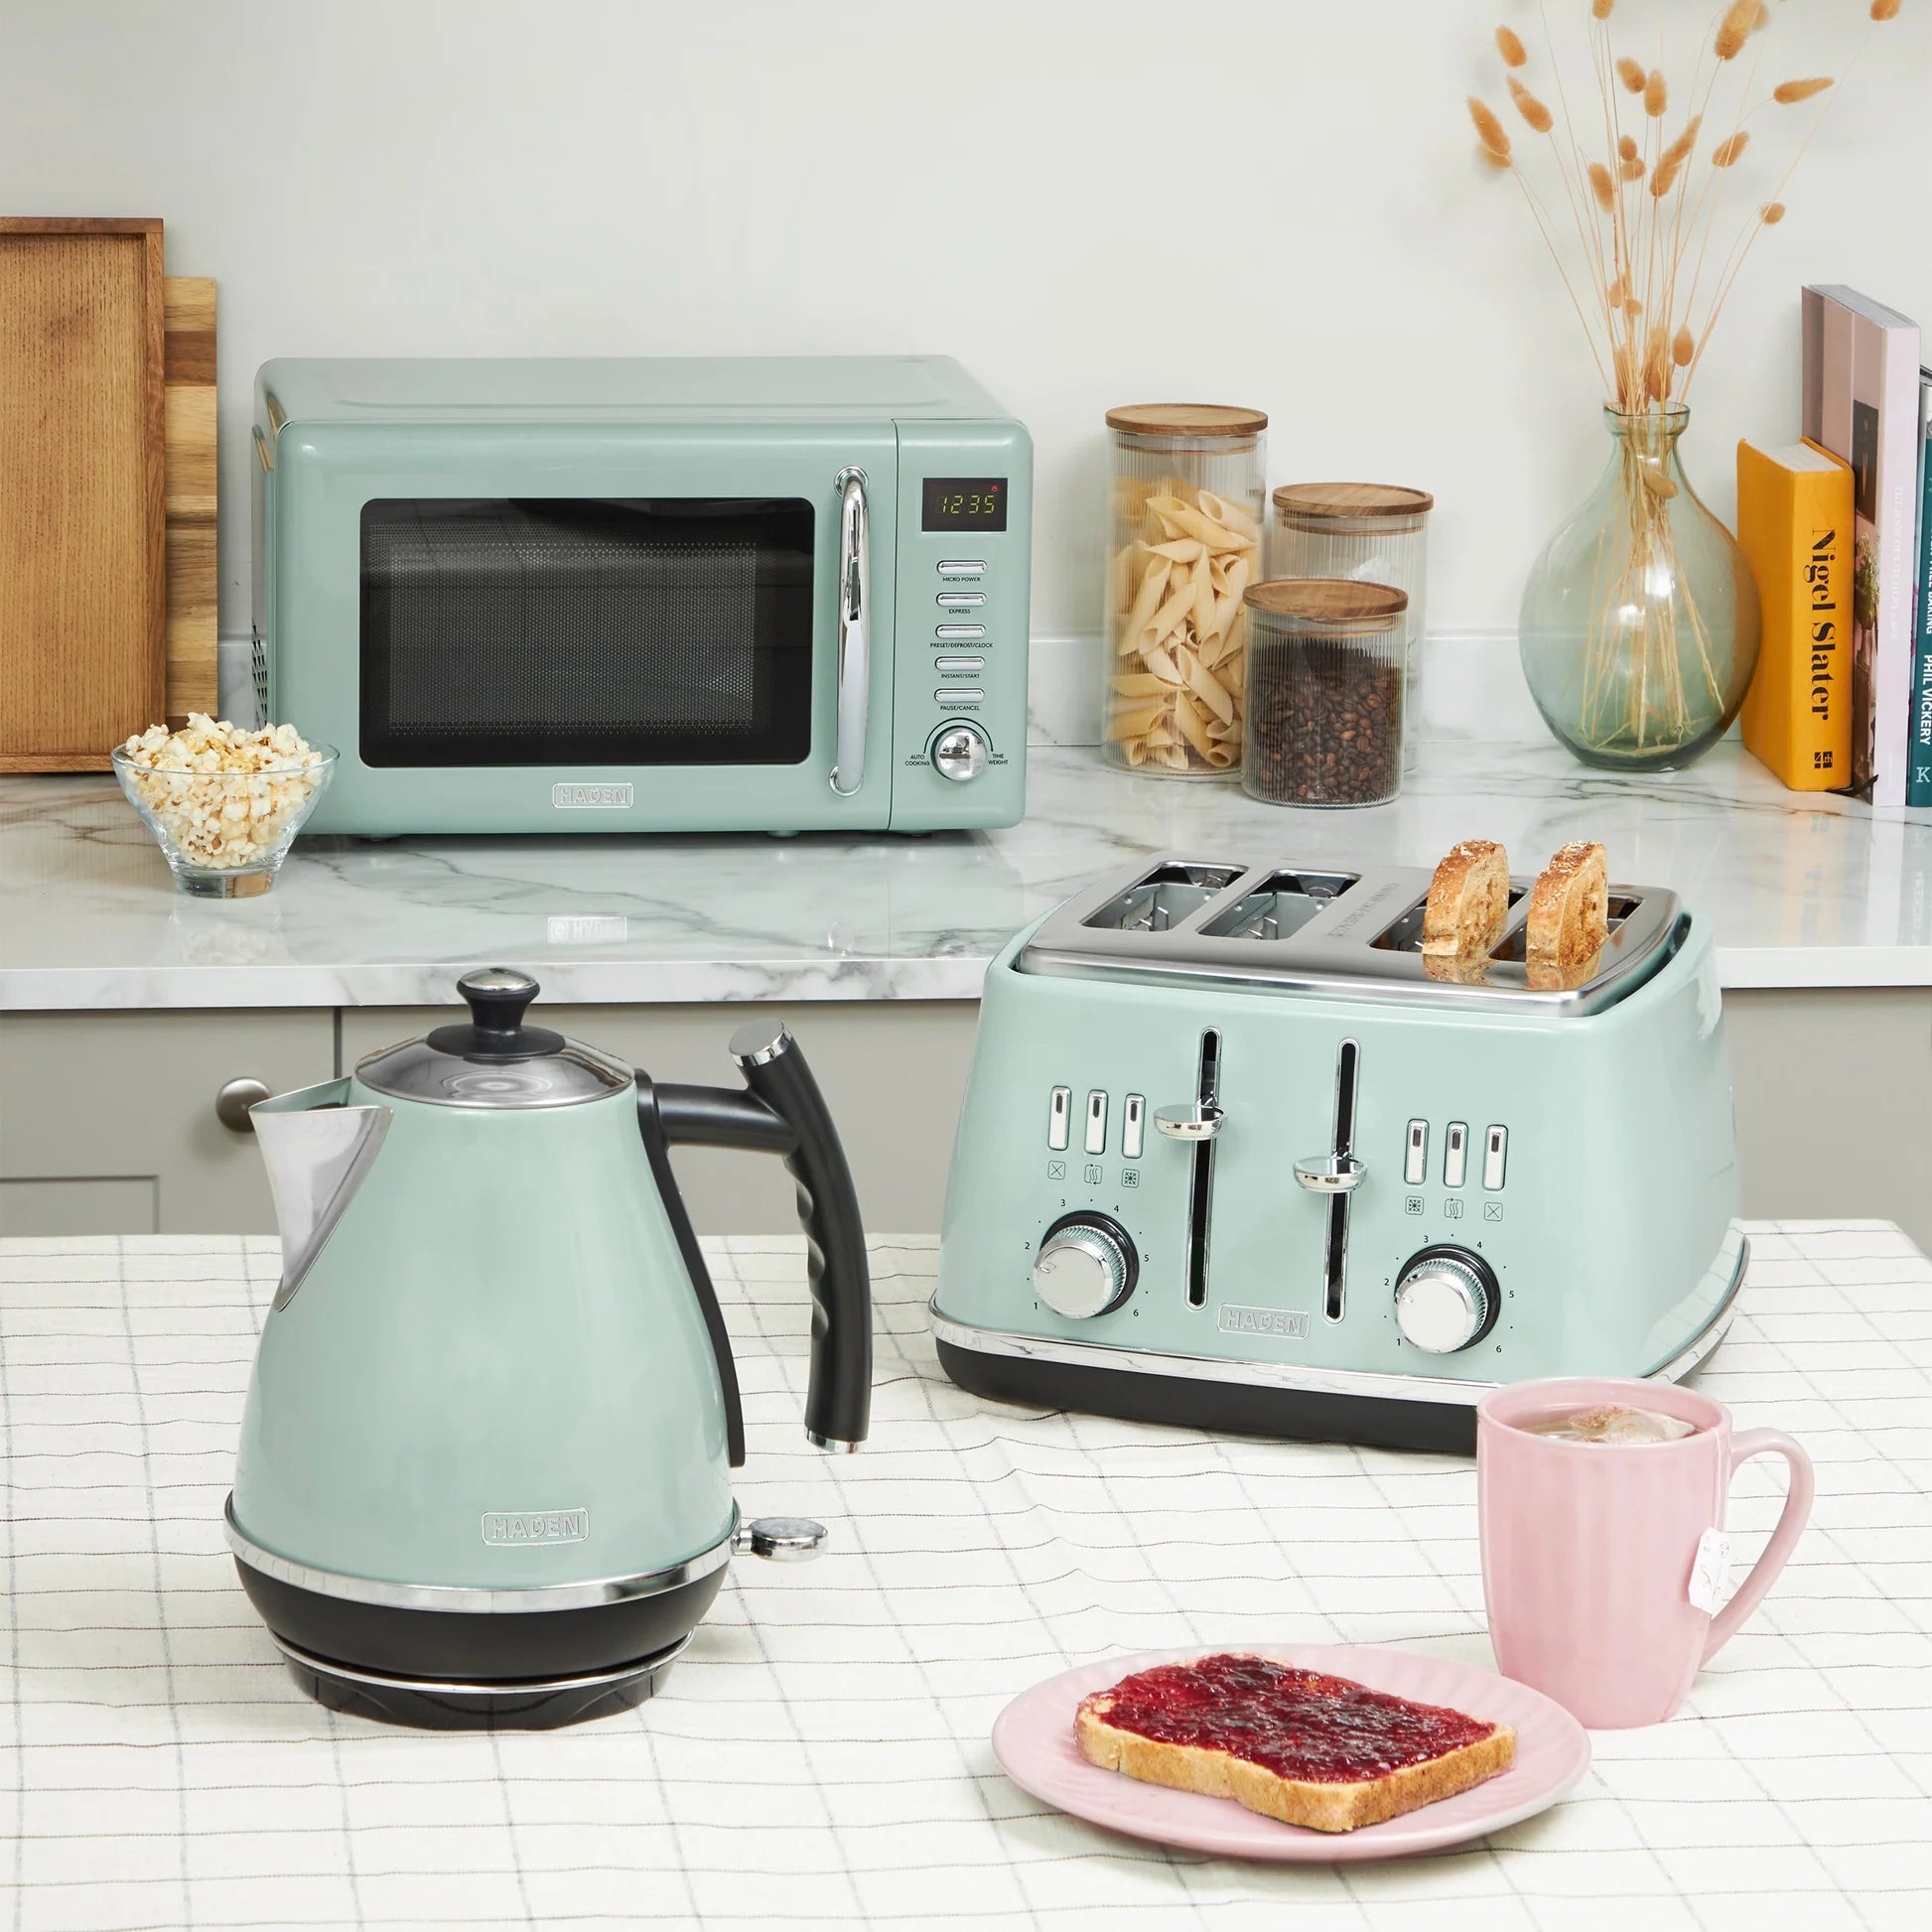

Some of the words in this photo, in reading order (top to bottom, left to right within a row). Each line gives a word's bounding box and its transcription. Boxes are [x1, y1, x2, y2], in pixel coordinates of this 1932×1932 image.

[1803, 527, 1837, 611] Nigel
[1810, 621, 1837, 721] Slater
[1923, 654, 1932, 685] PHIL
[1920, 687, 1932, 746] VICKERY
[1915, 766, 1931, 783] K
[559, 787, 627, 803] HADEN
[1060, 1198, 1066, 1207] 3
[1113, 1204, 1120, 1213] 4
[1423, 1234, 1430, 1244] 3
[1024, 1241, 1031, 1250] 2
[1476, 1240, 1482, 1249] 4
[1144, 1254, 1150, 1263] 5
[1384, 1278, 1390, 1287] 2
[1508, 1290, 1515, 1299] 5
[1133, 1309, 1140, 1317] 6
[1225, 1310, 1303, 1333] HADEN
[1495, 1344, 1502, 1353] 6
[491, 1515, 580, 1539] HADEN
